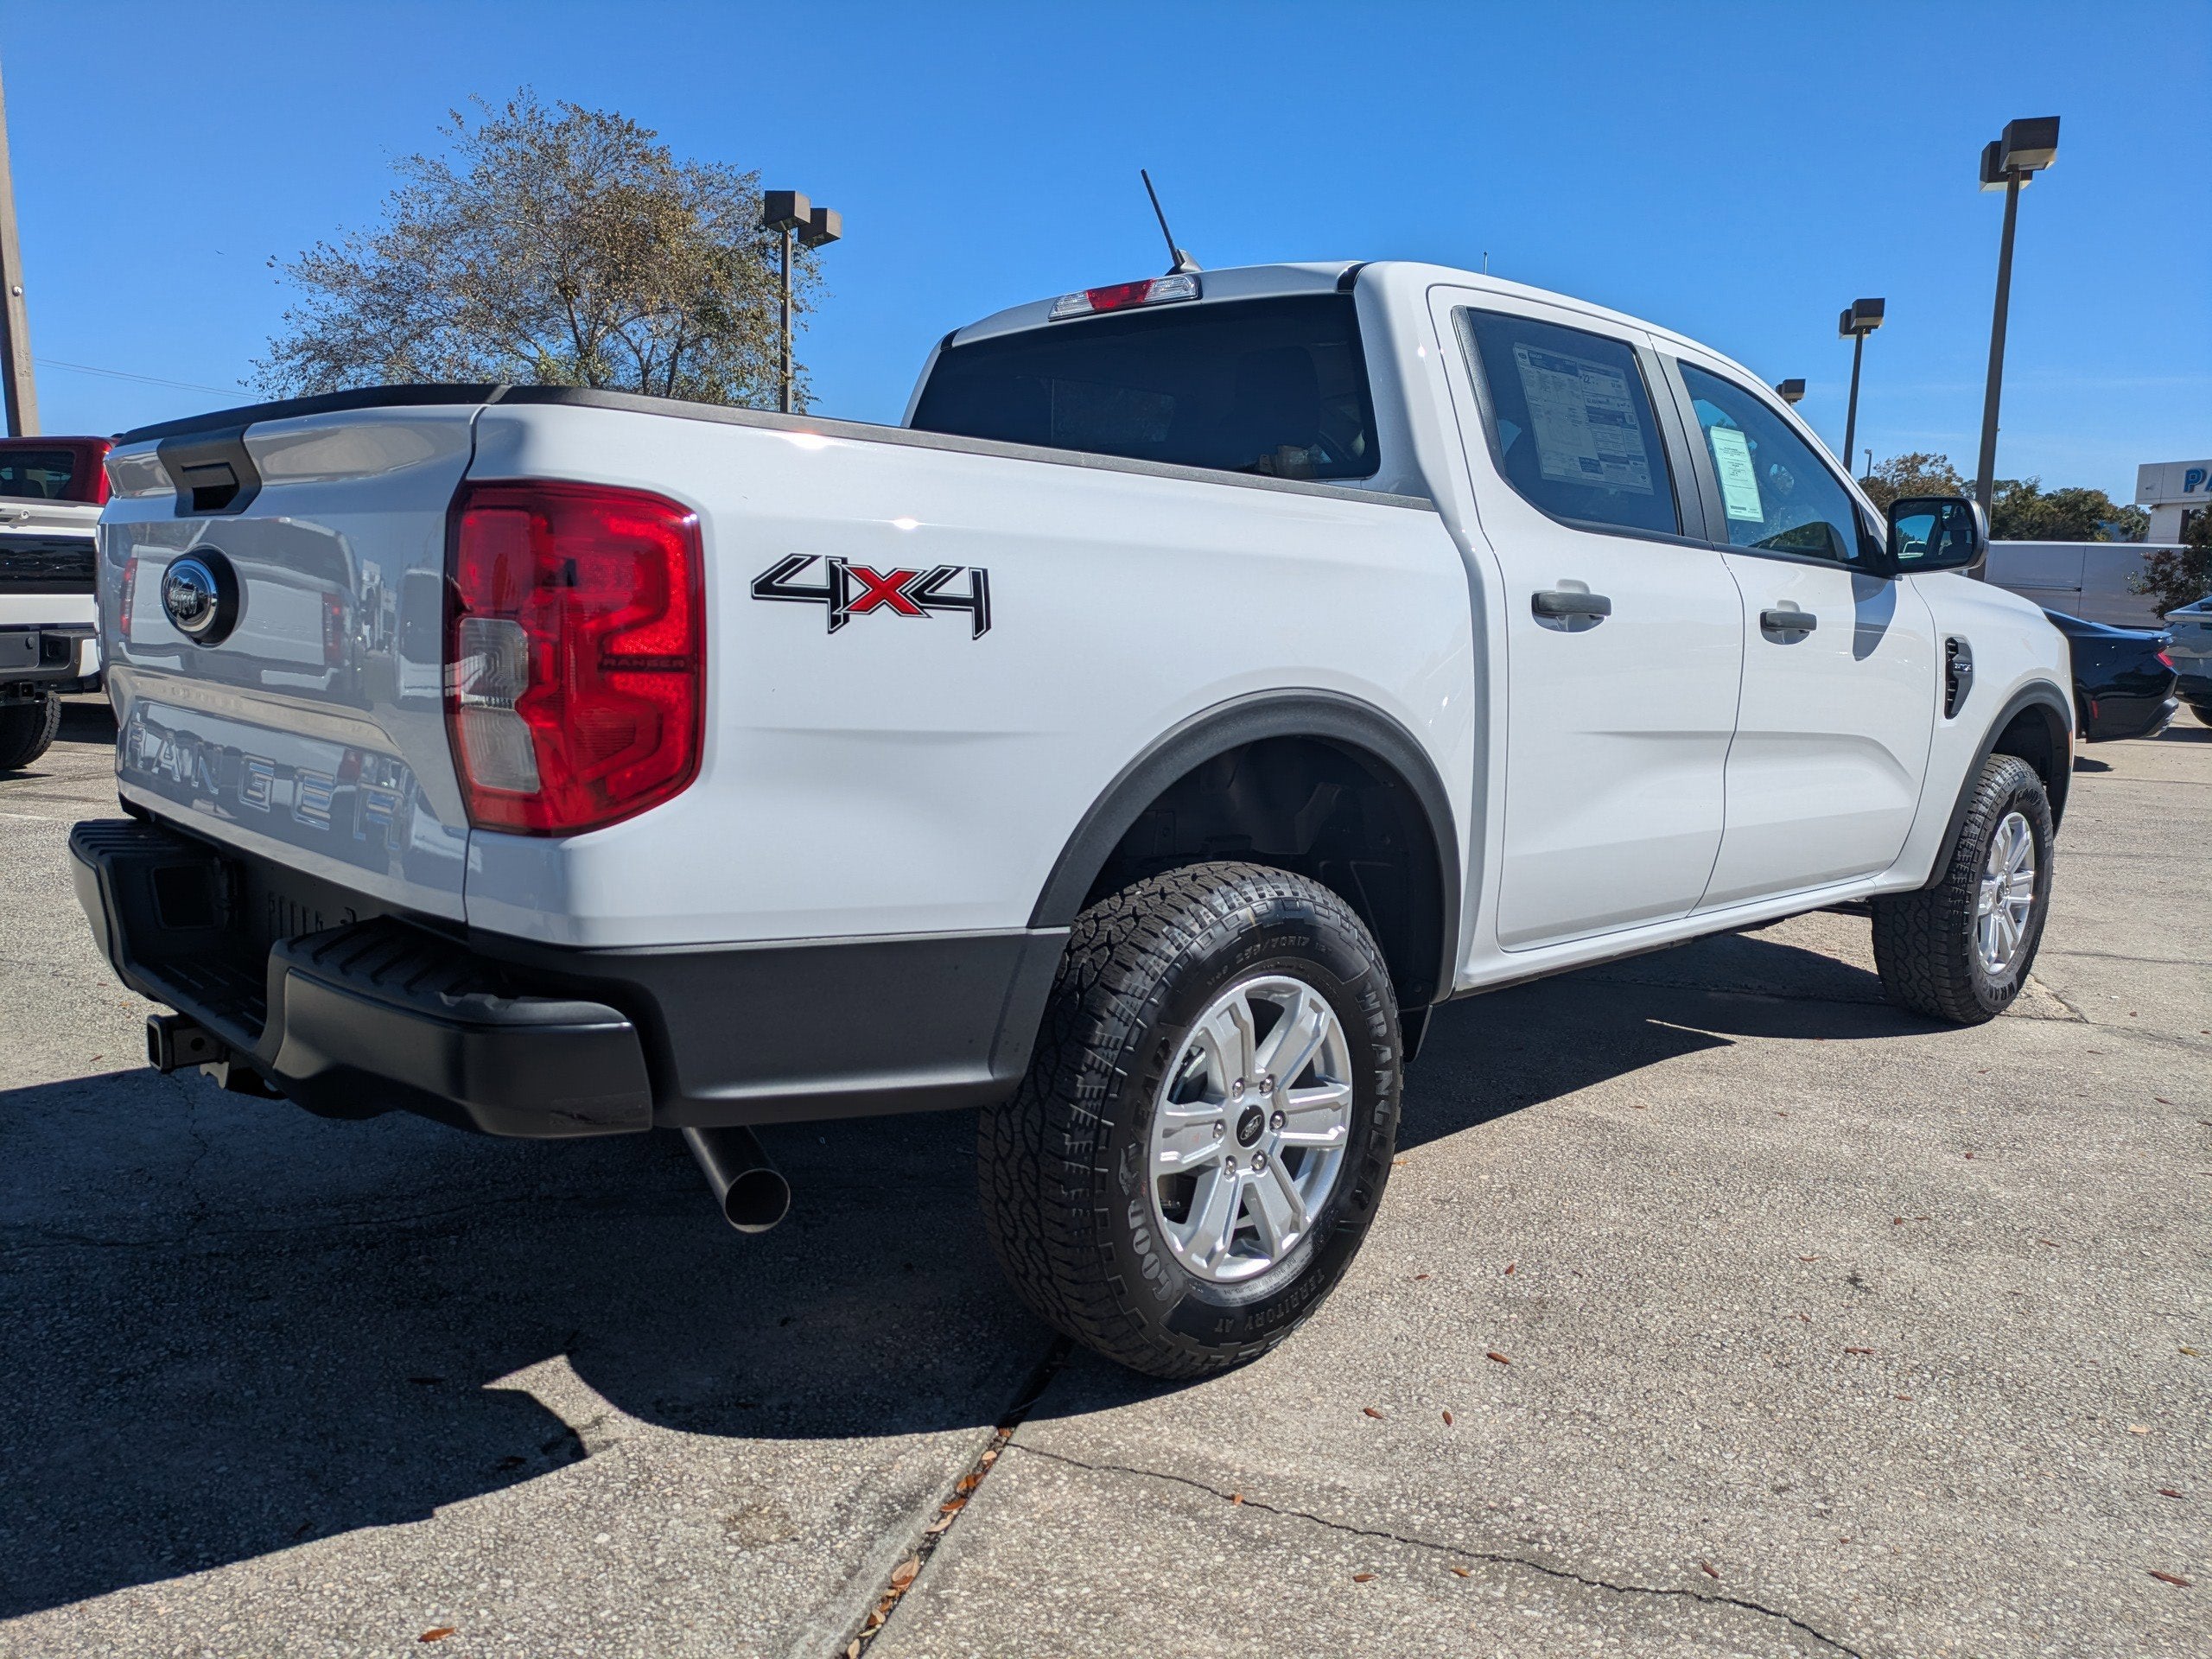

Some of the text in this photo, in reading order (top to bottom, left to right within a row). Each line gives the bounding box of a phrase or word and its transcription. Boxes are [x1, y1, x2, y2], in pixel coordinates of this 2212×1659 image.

[127, 719, 404, 850] RANGER
[1214, 1318, 1235, 1333] AT
[1243, 1268, 1326, 1332] TERRITORY
